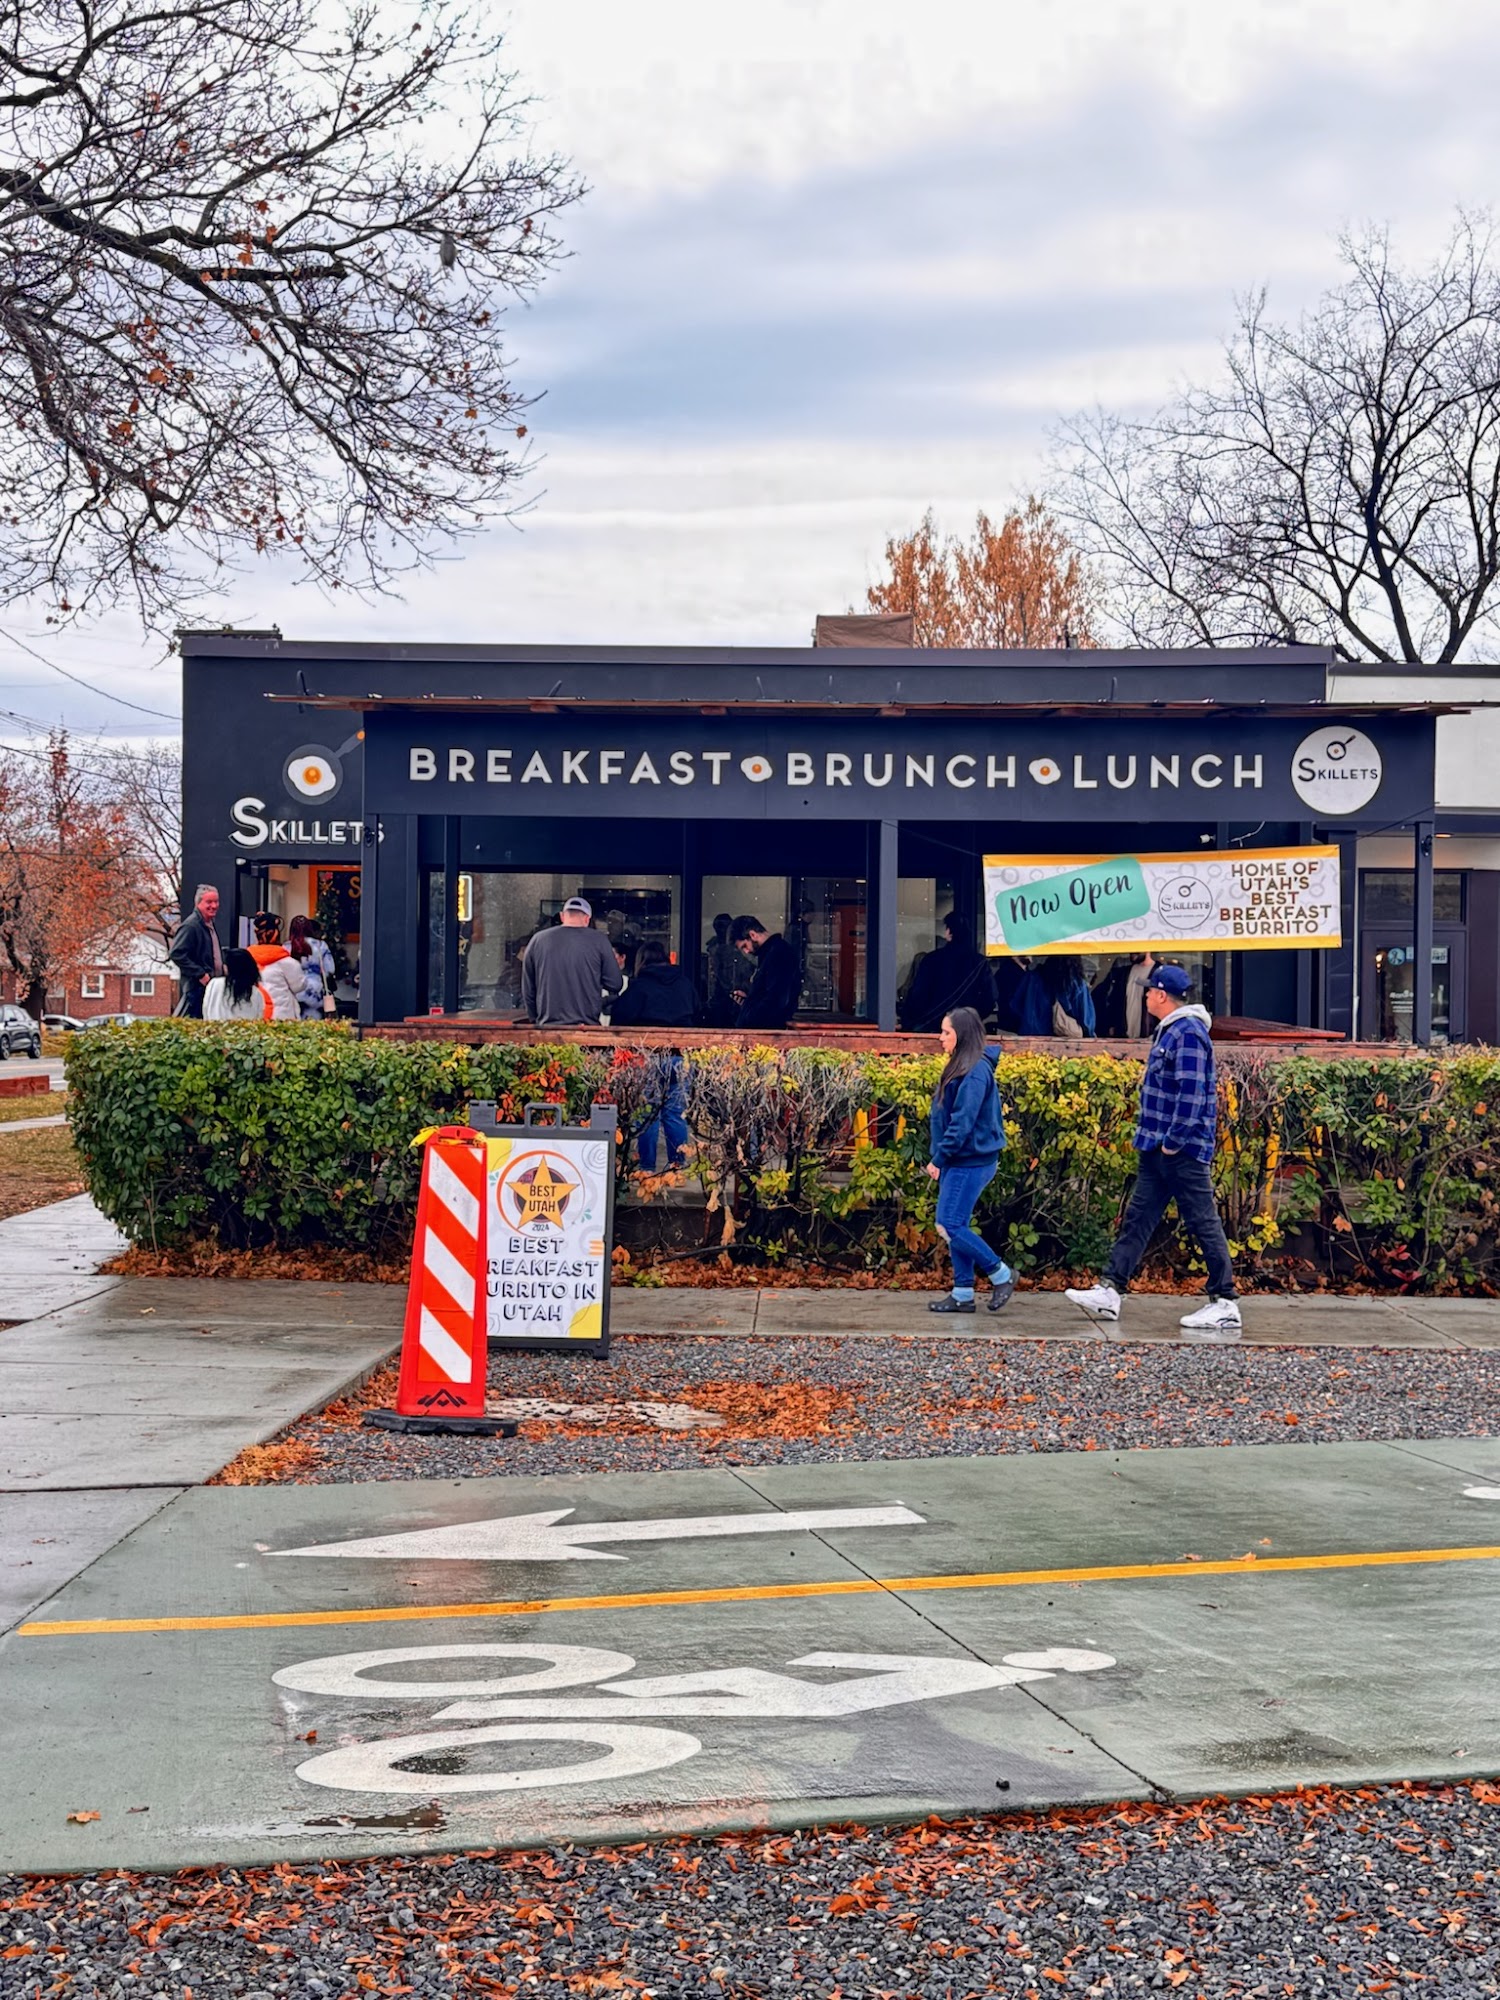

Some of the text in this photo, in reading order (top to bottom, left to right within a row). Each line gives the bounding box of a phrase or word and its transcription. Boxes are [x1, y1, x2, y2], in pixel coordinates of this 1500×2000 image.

[409, 747, 1263, 789] BREAKFAST BRUNCH LUNCH
[1297, 757, 1378, 782] SKILLETS
[1231, 861, 1318, 877] HOME OF
[1240, 876, 1310, 891] UTAH'S
[1069, 874, 1133, 914] Open
[1251, 891, 1300, 906] BEST
[1220, 905, 1332, 921] BREAKFAST
[1233, 920, 1318, 935] BURRITO
[529, 1185, 557, 1198] BEST
[529, 1200, 556, 1213] UTAH
[509, 1236, 565, 1254] BEST
[487, 1258, 599, 1278] REAKFAST
[487, 1280, 598, 1300] URRITO IN
[503, 1303, 563, 1321] UTAH
